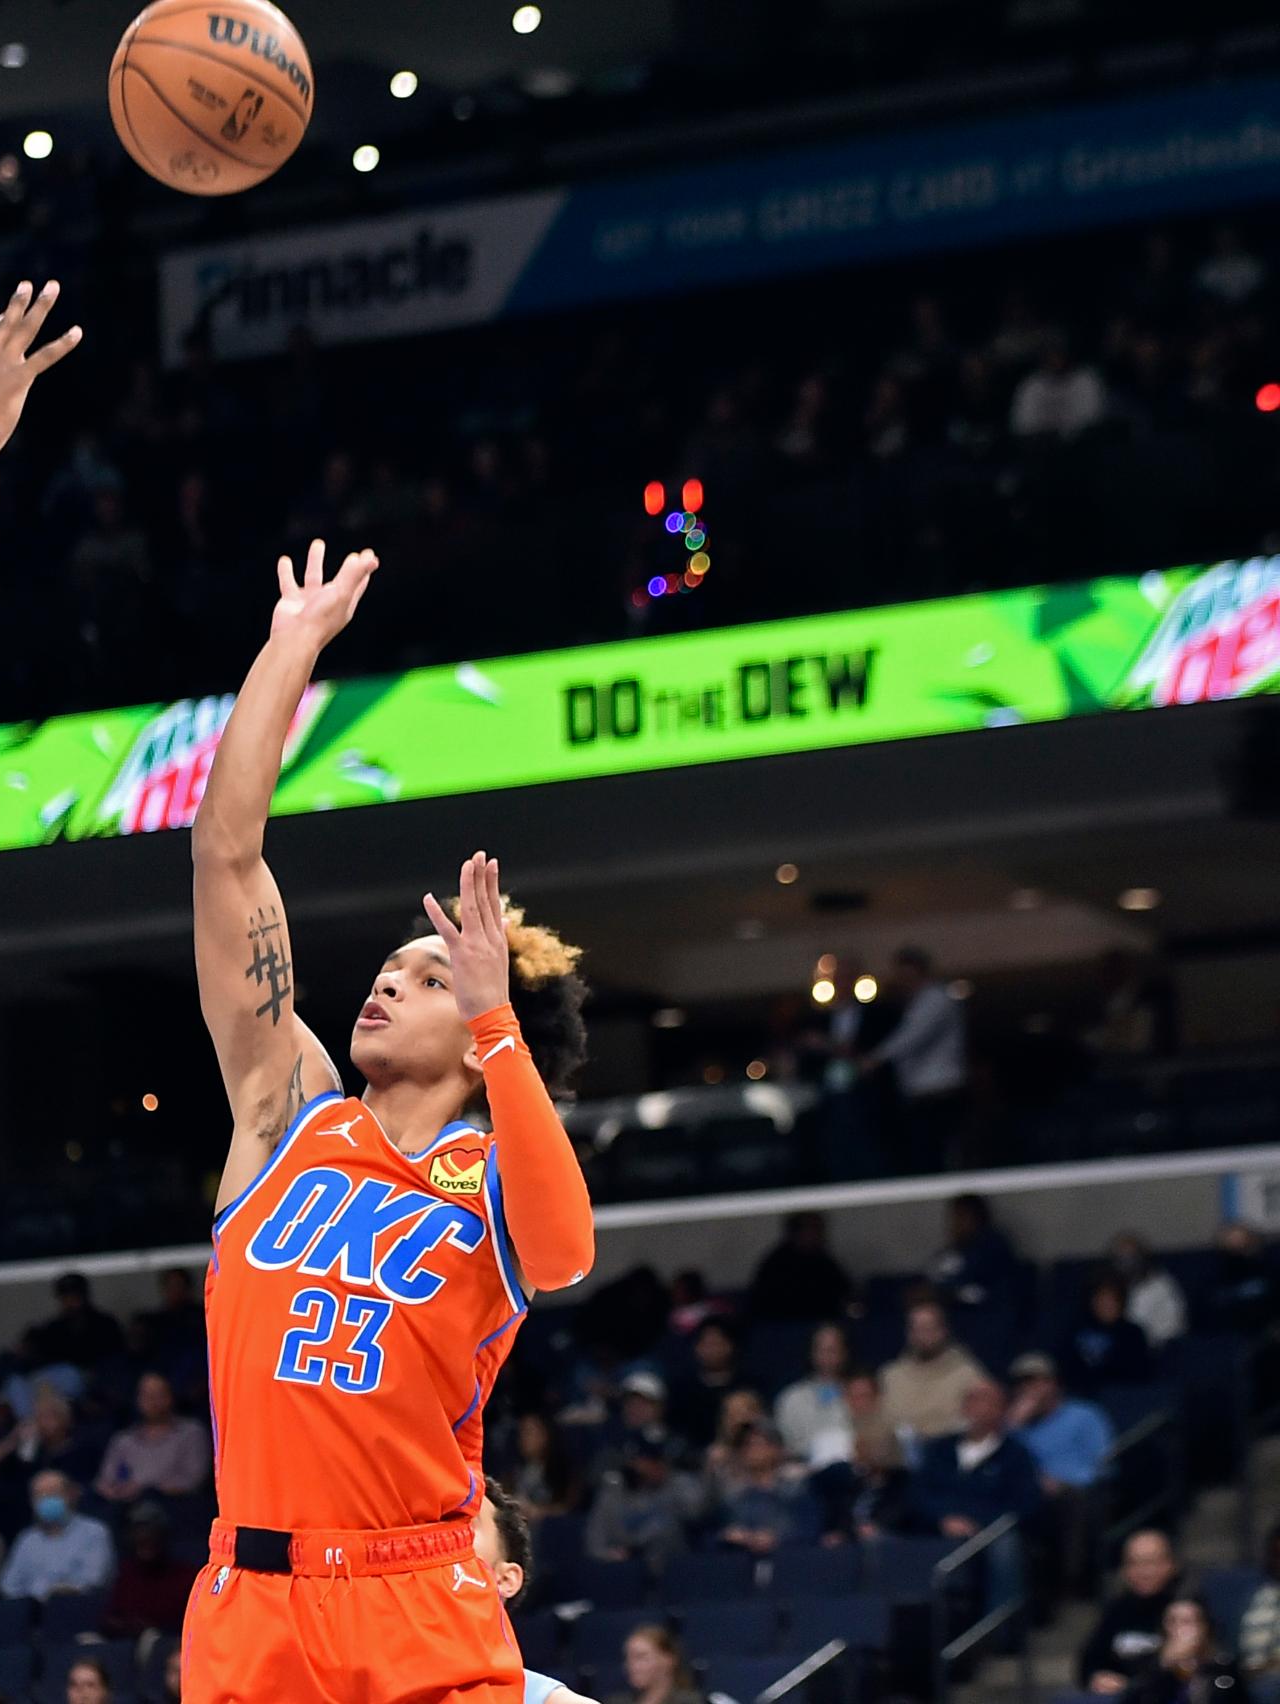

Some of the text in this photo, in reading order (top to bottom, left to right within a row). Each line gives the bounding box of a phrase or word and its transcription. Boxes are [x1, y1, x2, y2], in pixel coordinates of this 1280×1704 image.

[207, 13, 311, 105] Wilson
[195, 229, 473, 325] Pinnacle
[567, 678, 641, 743] DO
[737, 648, 878, 722] DEW
[245, 1166, 487, 1305] OKC
[273, 1286, 394, 1393] 23
